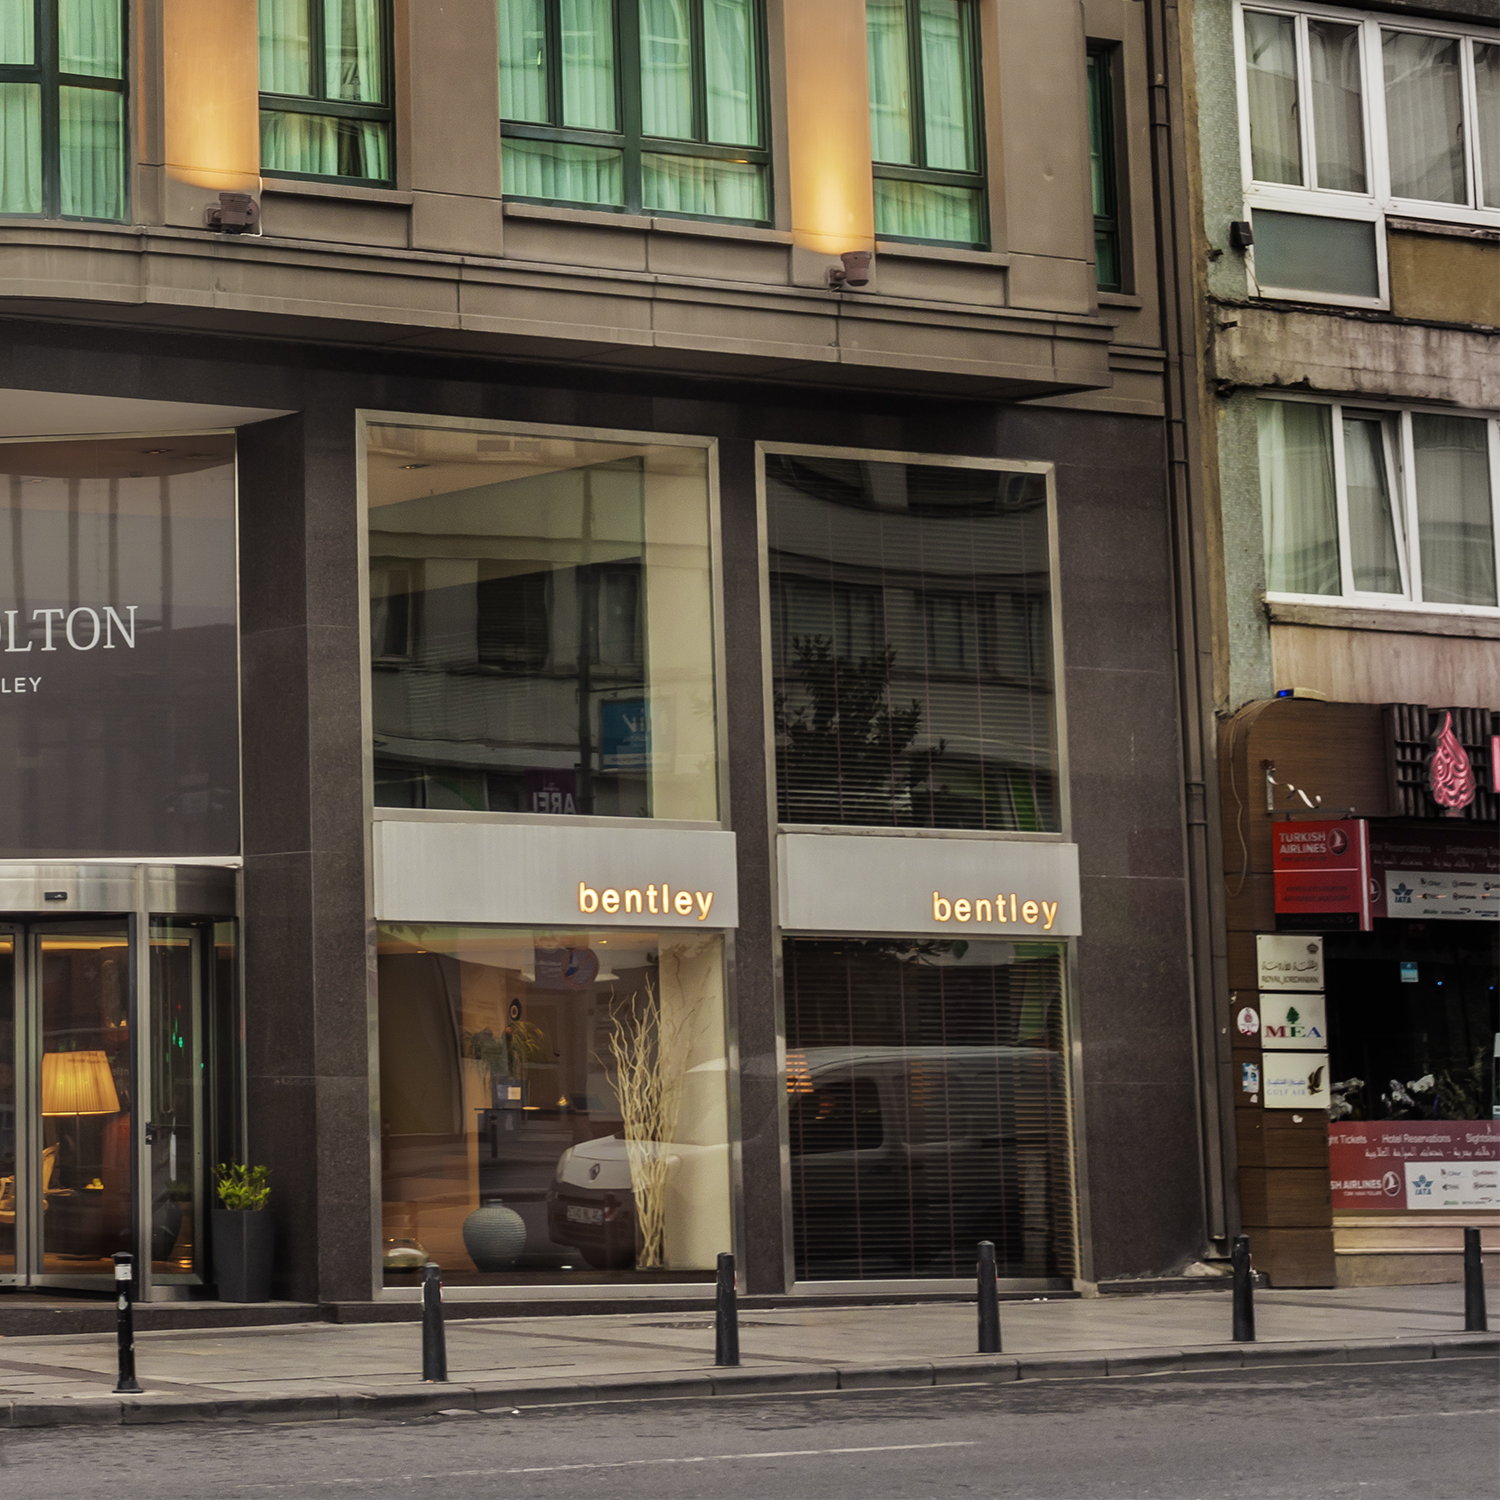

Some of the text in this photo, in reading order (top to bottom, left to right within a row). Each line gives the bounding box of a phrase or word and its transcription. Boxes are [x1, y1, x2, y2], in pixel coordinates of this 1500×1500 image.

[1279, 832, 1326, 843] TURKISH
[1279, 843, 1327, 854] AIRLINES
[578, 880, 714, 921] bentley
[932, 890, 1059, 930] bentley
[1281, 975, 1319, 984] JORDANIAN
[1264, 1025, 1323, 1038] MEA
[1339, 1134, 1368, 1144] Tickets
[1382, 1134, 1402, 1144] Hotel
[1403, 1133, 1451, 1144] Reservations
[1343, 1180, 1382, 1189] AIRLINES
[1415, 1188, 1432, 1196] IATA
